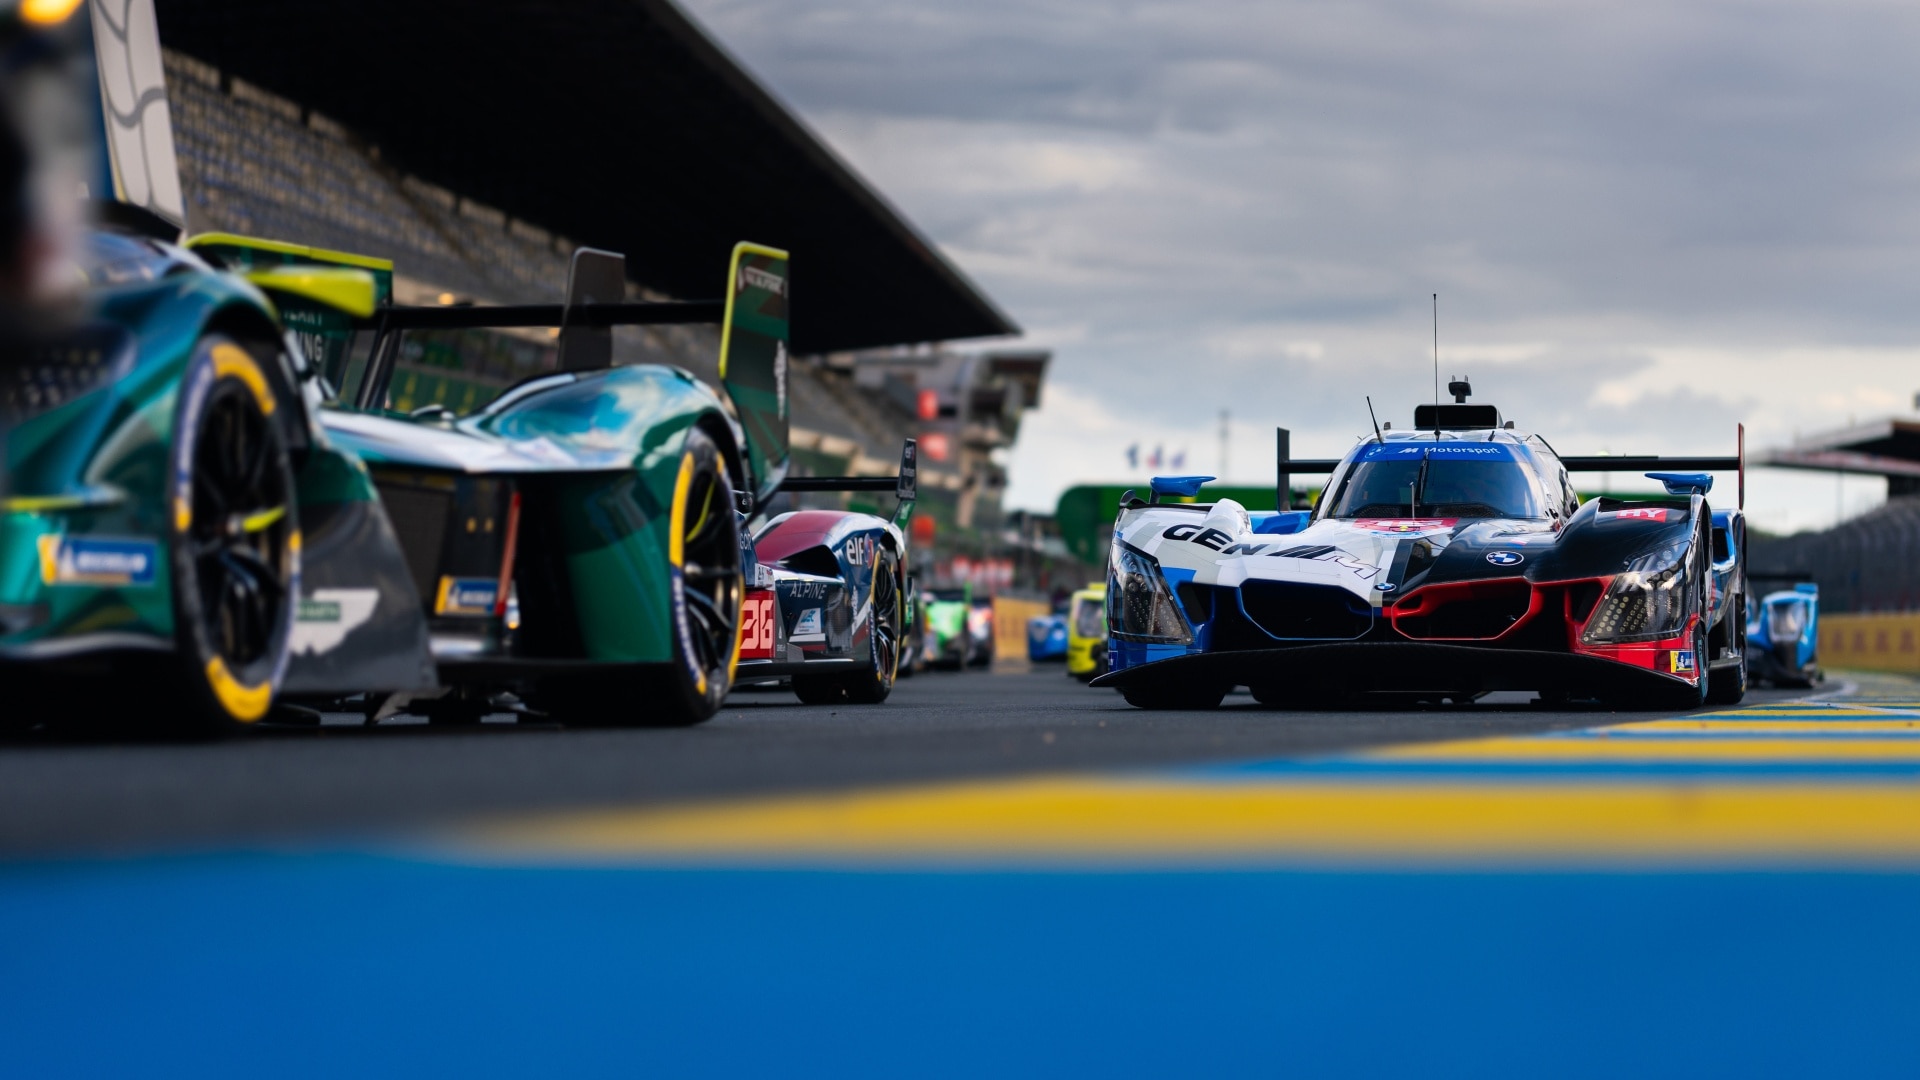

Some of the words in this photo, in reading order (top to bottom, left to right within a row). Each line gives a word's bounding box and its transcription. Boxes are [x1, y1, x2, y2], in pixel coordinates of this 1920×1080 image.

[1424, 446, 1500, 454] Motorsport
[846, 537, 864, 565] elf
[1162, 524, 1270, 556] GEN
[789, 581, 827, 600] ALPINE
[740, 599, 774, 650] 36
